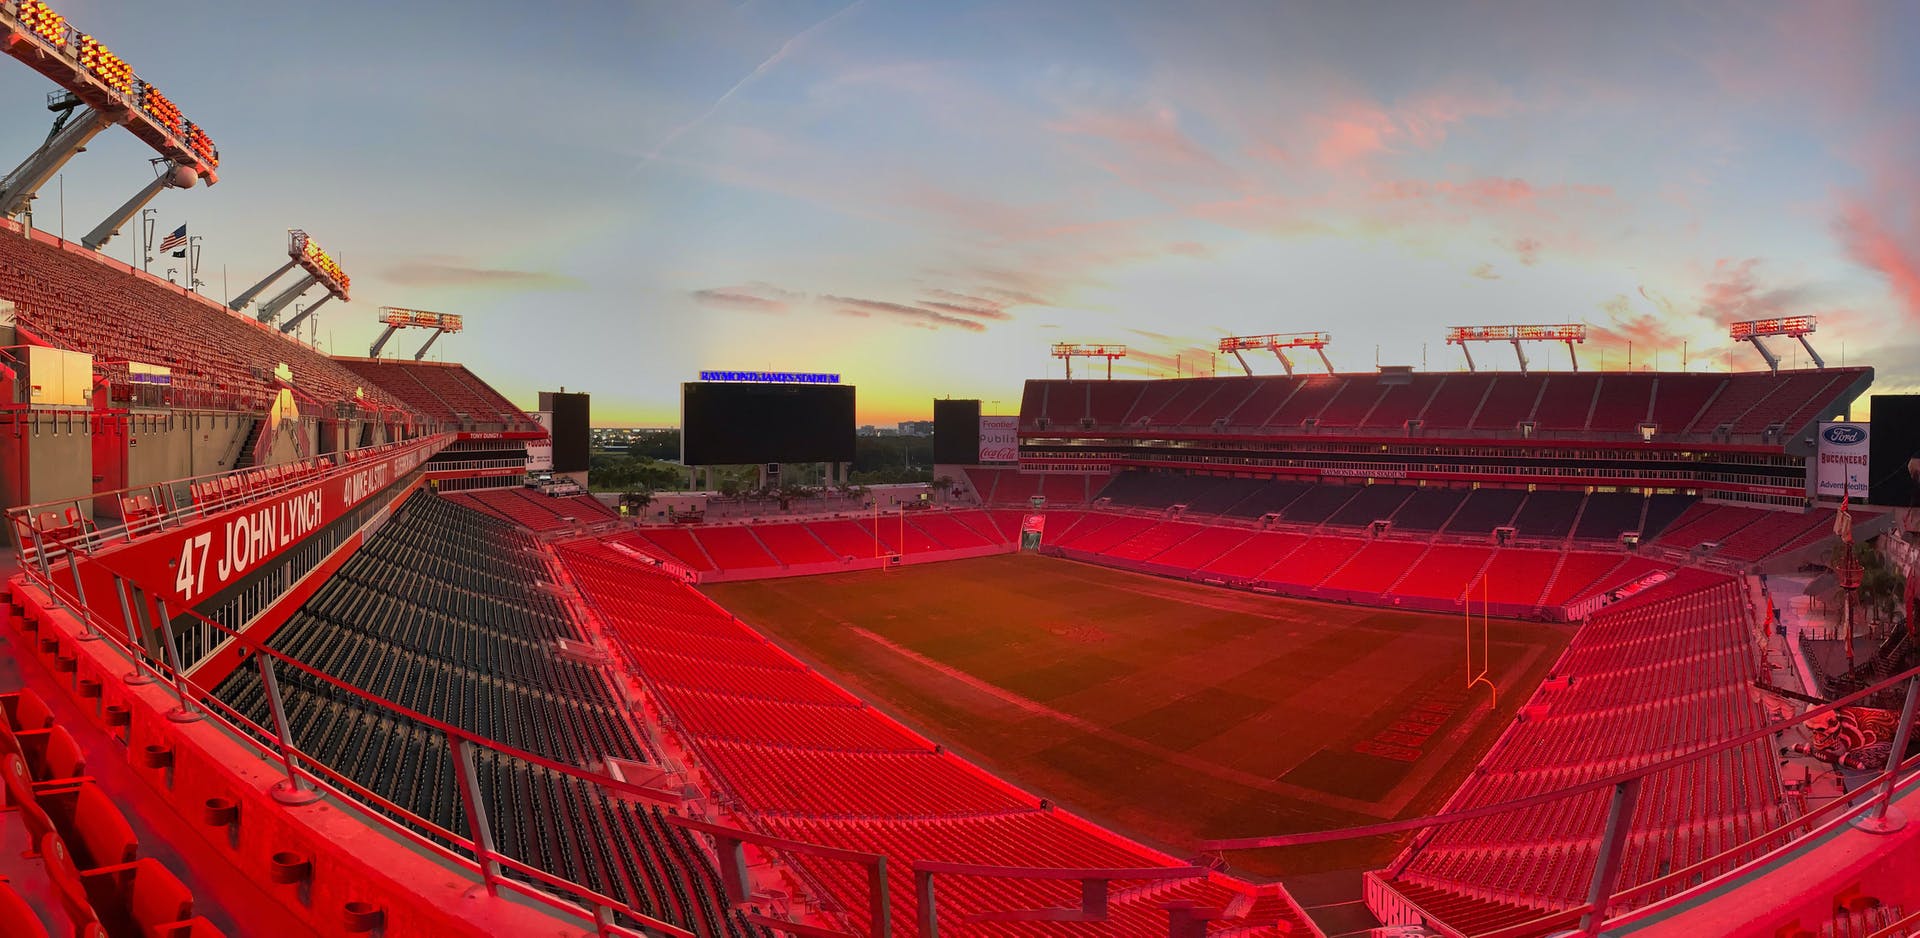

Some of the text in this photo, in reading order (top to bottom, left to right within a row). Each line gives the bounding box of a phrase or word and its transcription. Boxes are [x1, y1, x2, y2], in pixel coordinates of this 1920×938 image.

[701, 371, 839, 383] RAYMOND JAMES STADIUM
[1831, 427, 1858, 442] Ford
[1821, 453, 1868, 466] BUCCANEERS
[1321, 468, 1407, 479] RAYMOND JAMES STADIUM
[343, 477, 352, 508] 40
[353, 470, 369, 504] MIKE
[1820, 480, 1868, 491] Adventealth
[176, 488, 322, 601] 47 JOHN LYNCH
